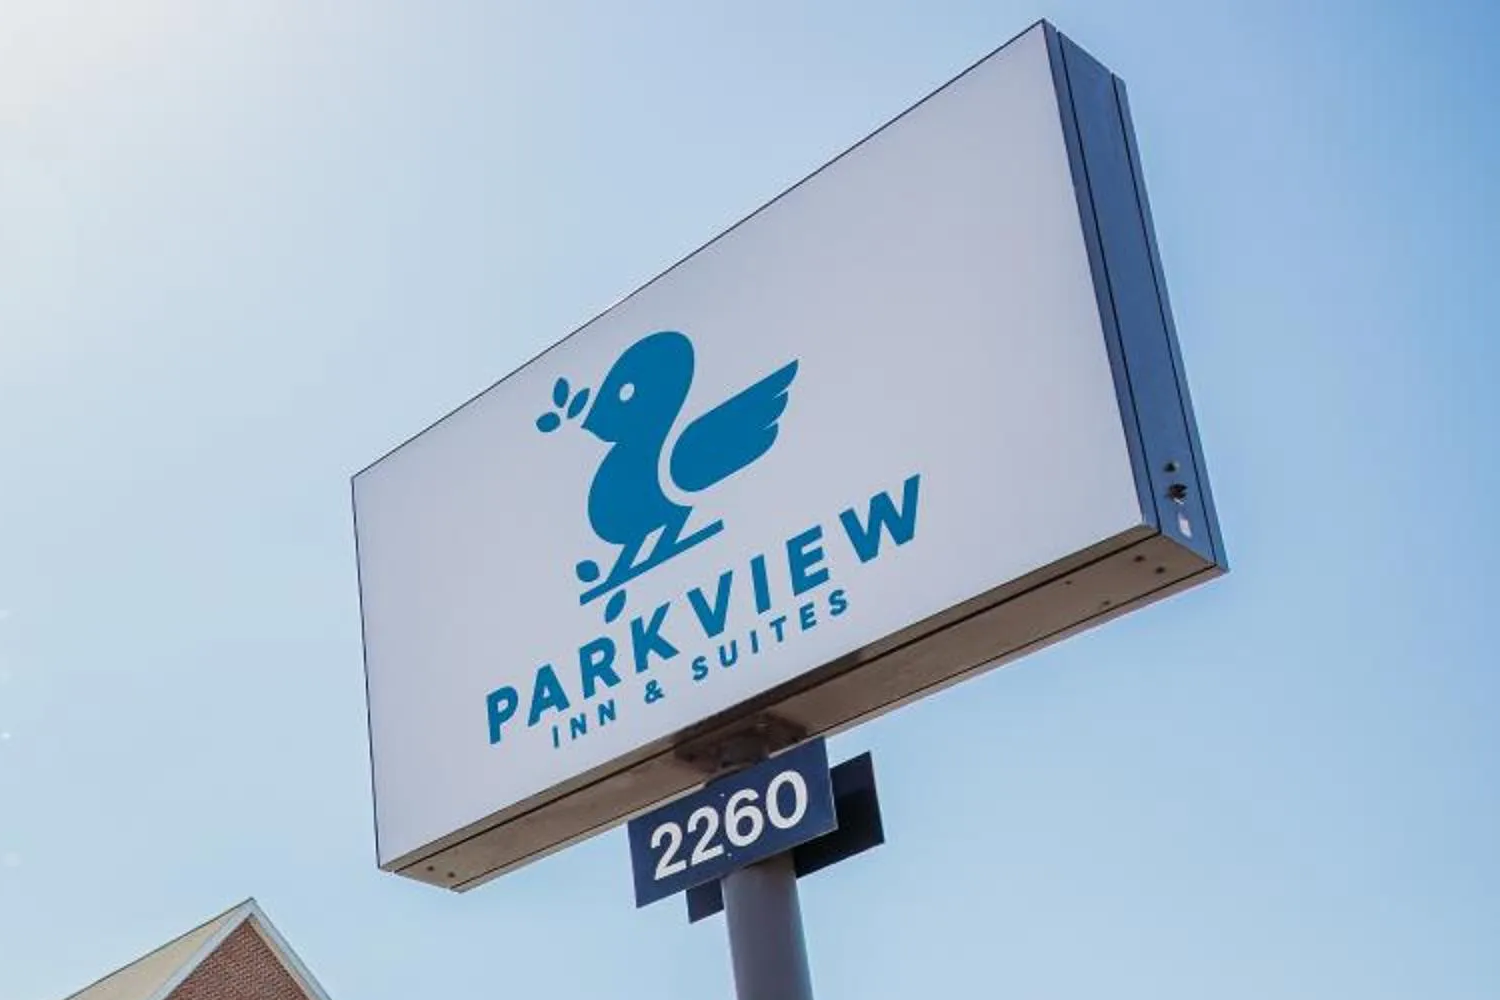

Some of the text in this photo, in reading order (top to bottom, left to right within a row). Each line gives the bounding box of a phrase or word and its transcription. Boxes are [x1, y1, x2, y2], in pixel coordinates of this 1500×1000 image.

[485, 473, 921, 744] PARKVIEW
[552, 588, 850, 747] INN & SUITES
[650, 769, 808, 881] 2260
